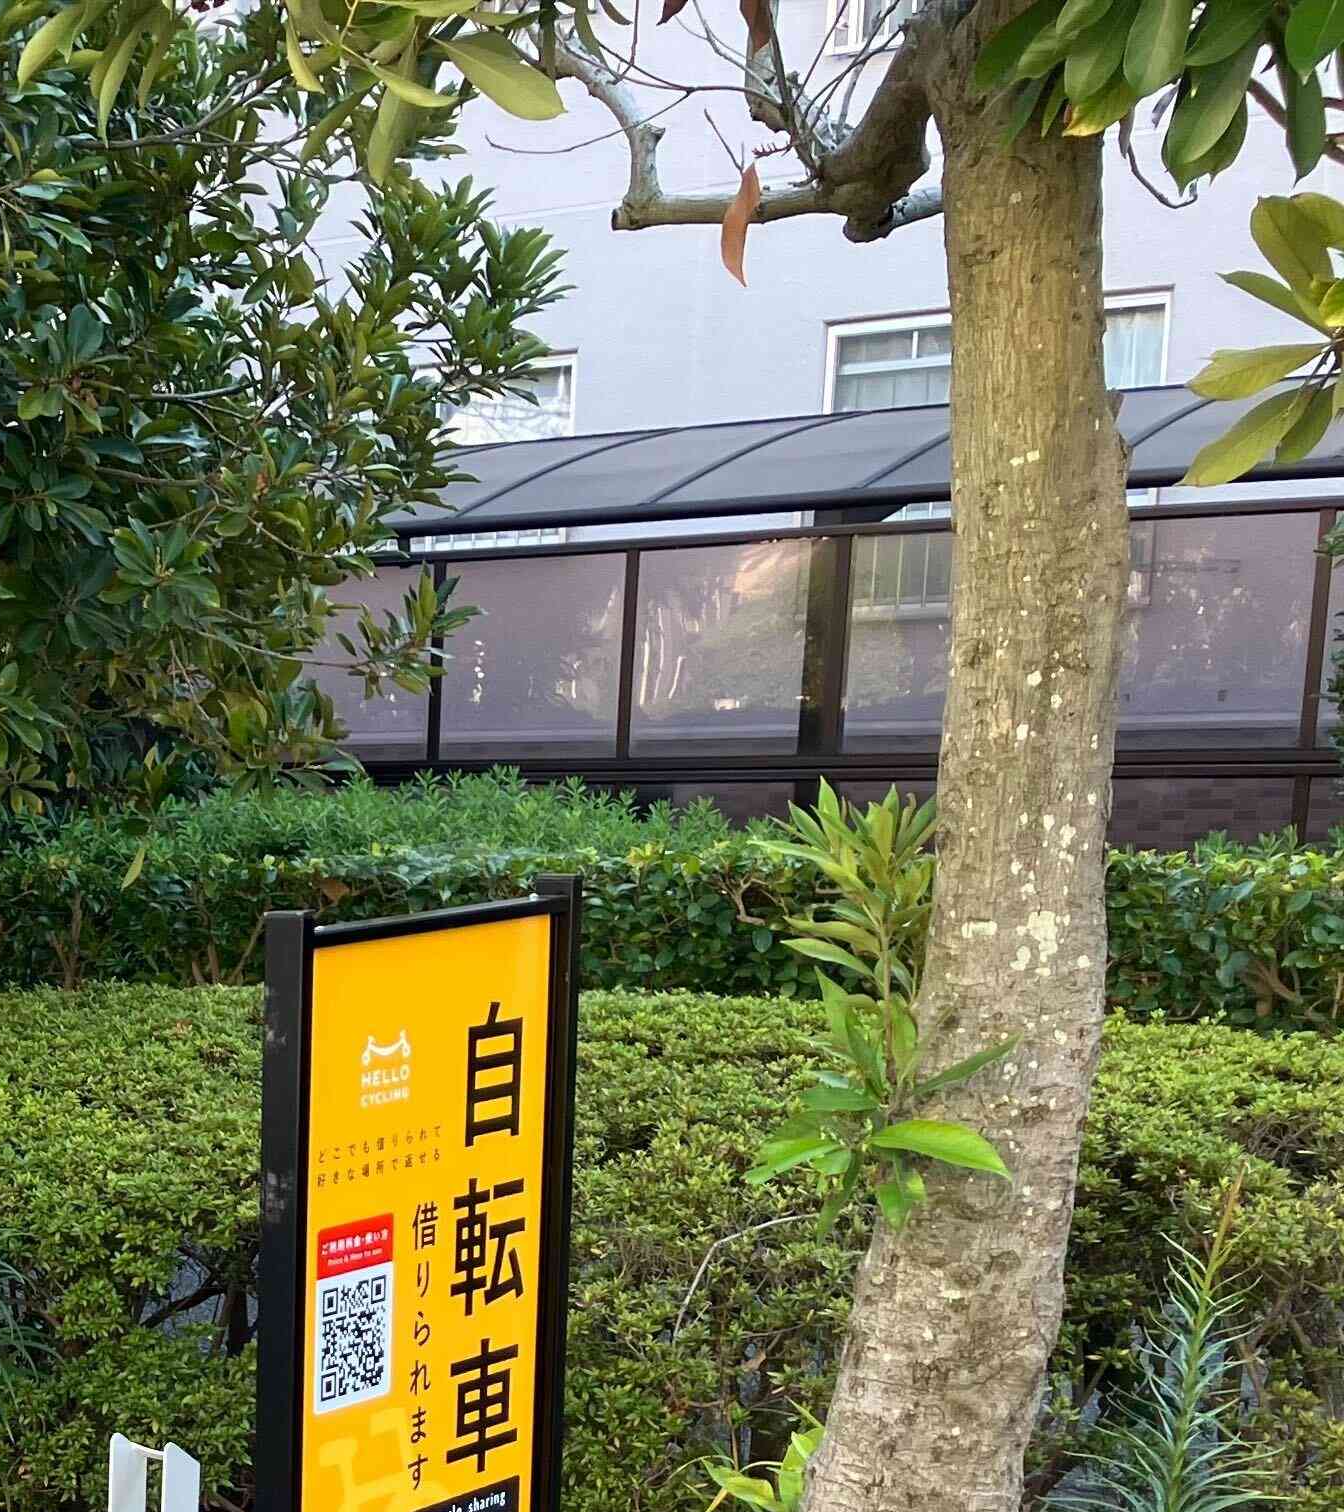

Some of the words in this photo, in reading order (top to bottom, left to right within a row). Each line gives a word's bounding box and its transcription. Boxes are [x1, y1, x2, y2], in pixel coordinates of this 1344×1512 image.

[361, 1064, 410, 1088] HELLO
[360, 1087, 410, 1108] CYCLING
[318, 1125, 441, 1164] どこでも借りられて
[317, 1148, 440, 1188] 好きな場所で返せる
[445, 1001, 526, 1474] 自転車
[407, 1201, 439, 1490] 借りられます
